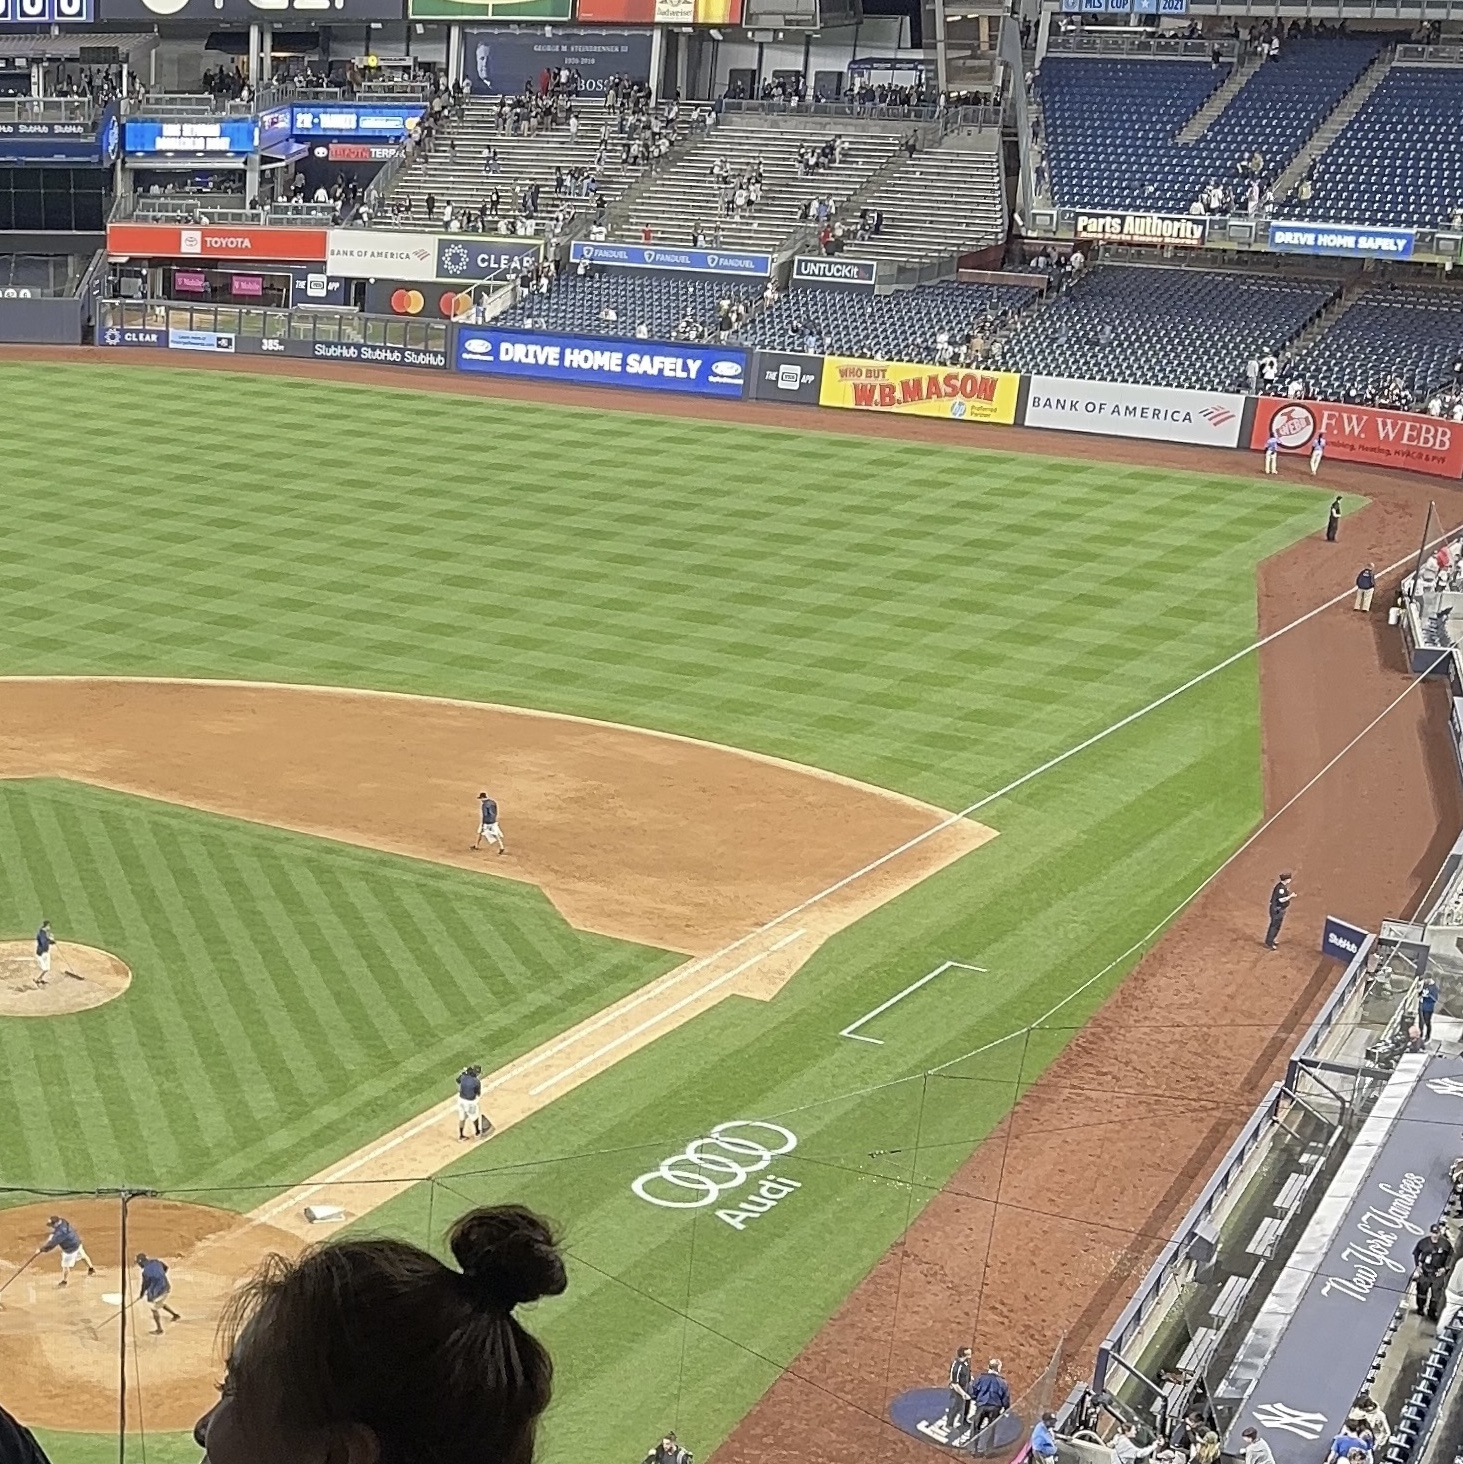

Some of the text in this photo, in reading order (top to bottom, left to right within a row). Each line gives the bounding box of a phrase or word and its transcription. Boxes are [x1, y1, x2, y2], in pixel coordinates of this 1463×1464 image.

[1110, 0, 1128, 9] CUP
[1162, 0, 1184, 10] 2021
[1077, 215, 1204, 239] Parts Authority
[204, 236, 252, 249] TOYOTA
[1274, 231, 1408, 252] DRIVE HOME SAFELY
[330, 249, 411, 260] BANK OF AMERICA
[593, 249, 629, 260] FANDUEL
[655, 254, 691, 265] FANDUEL
[718, 258, 755, 269] FANDUEL
[801, 261, 859, 279] UNTUCKit
[124, 332, 158, 343] CLEAR
[314, 343, 358, 358] StubHub
[360, 346, 402, 362] StubHub
[404, 350, 445, 366] StubHub
[499, 341, 703, 380] DRIVE HOME SAFELY
[800, 375, 815, 385] APP
[839, 366, 887, 379] WHO BUT
[1031, 395, 1194, 425] BANK OF AMERICA
[1319, 410, 1452, 451] F.W. WEBB
[714, 1174, 802, 1231] Audi
[1320, 1172, 1426, 1302] New York Yankees
